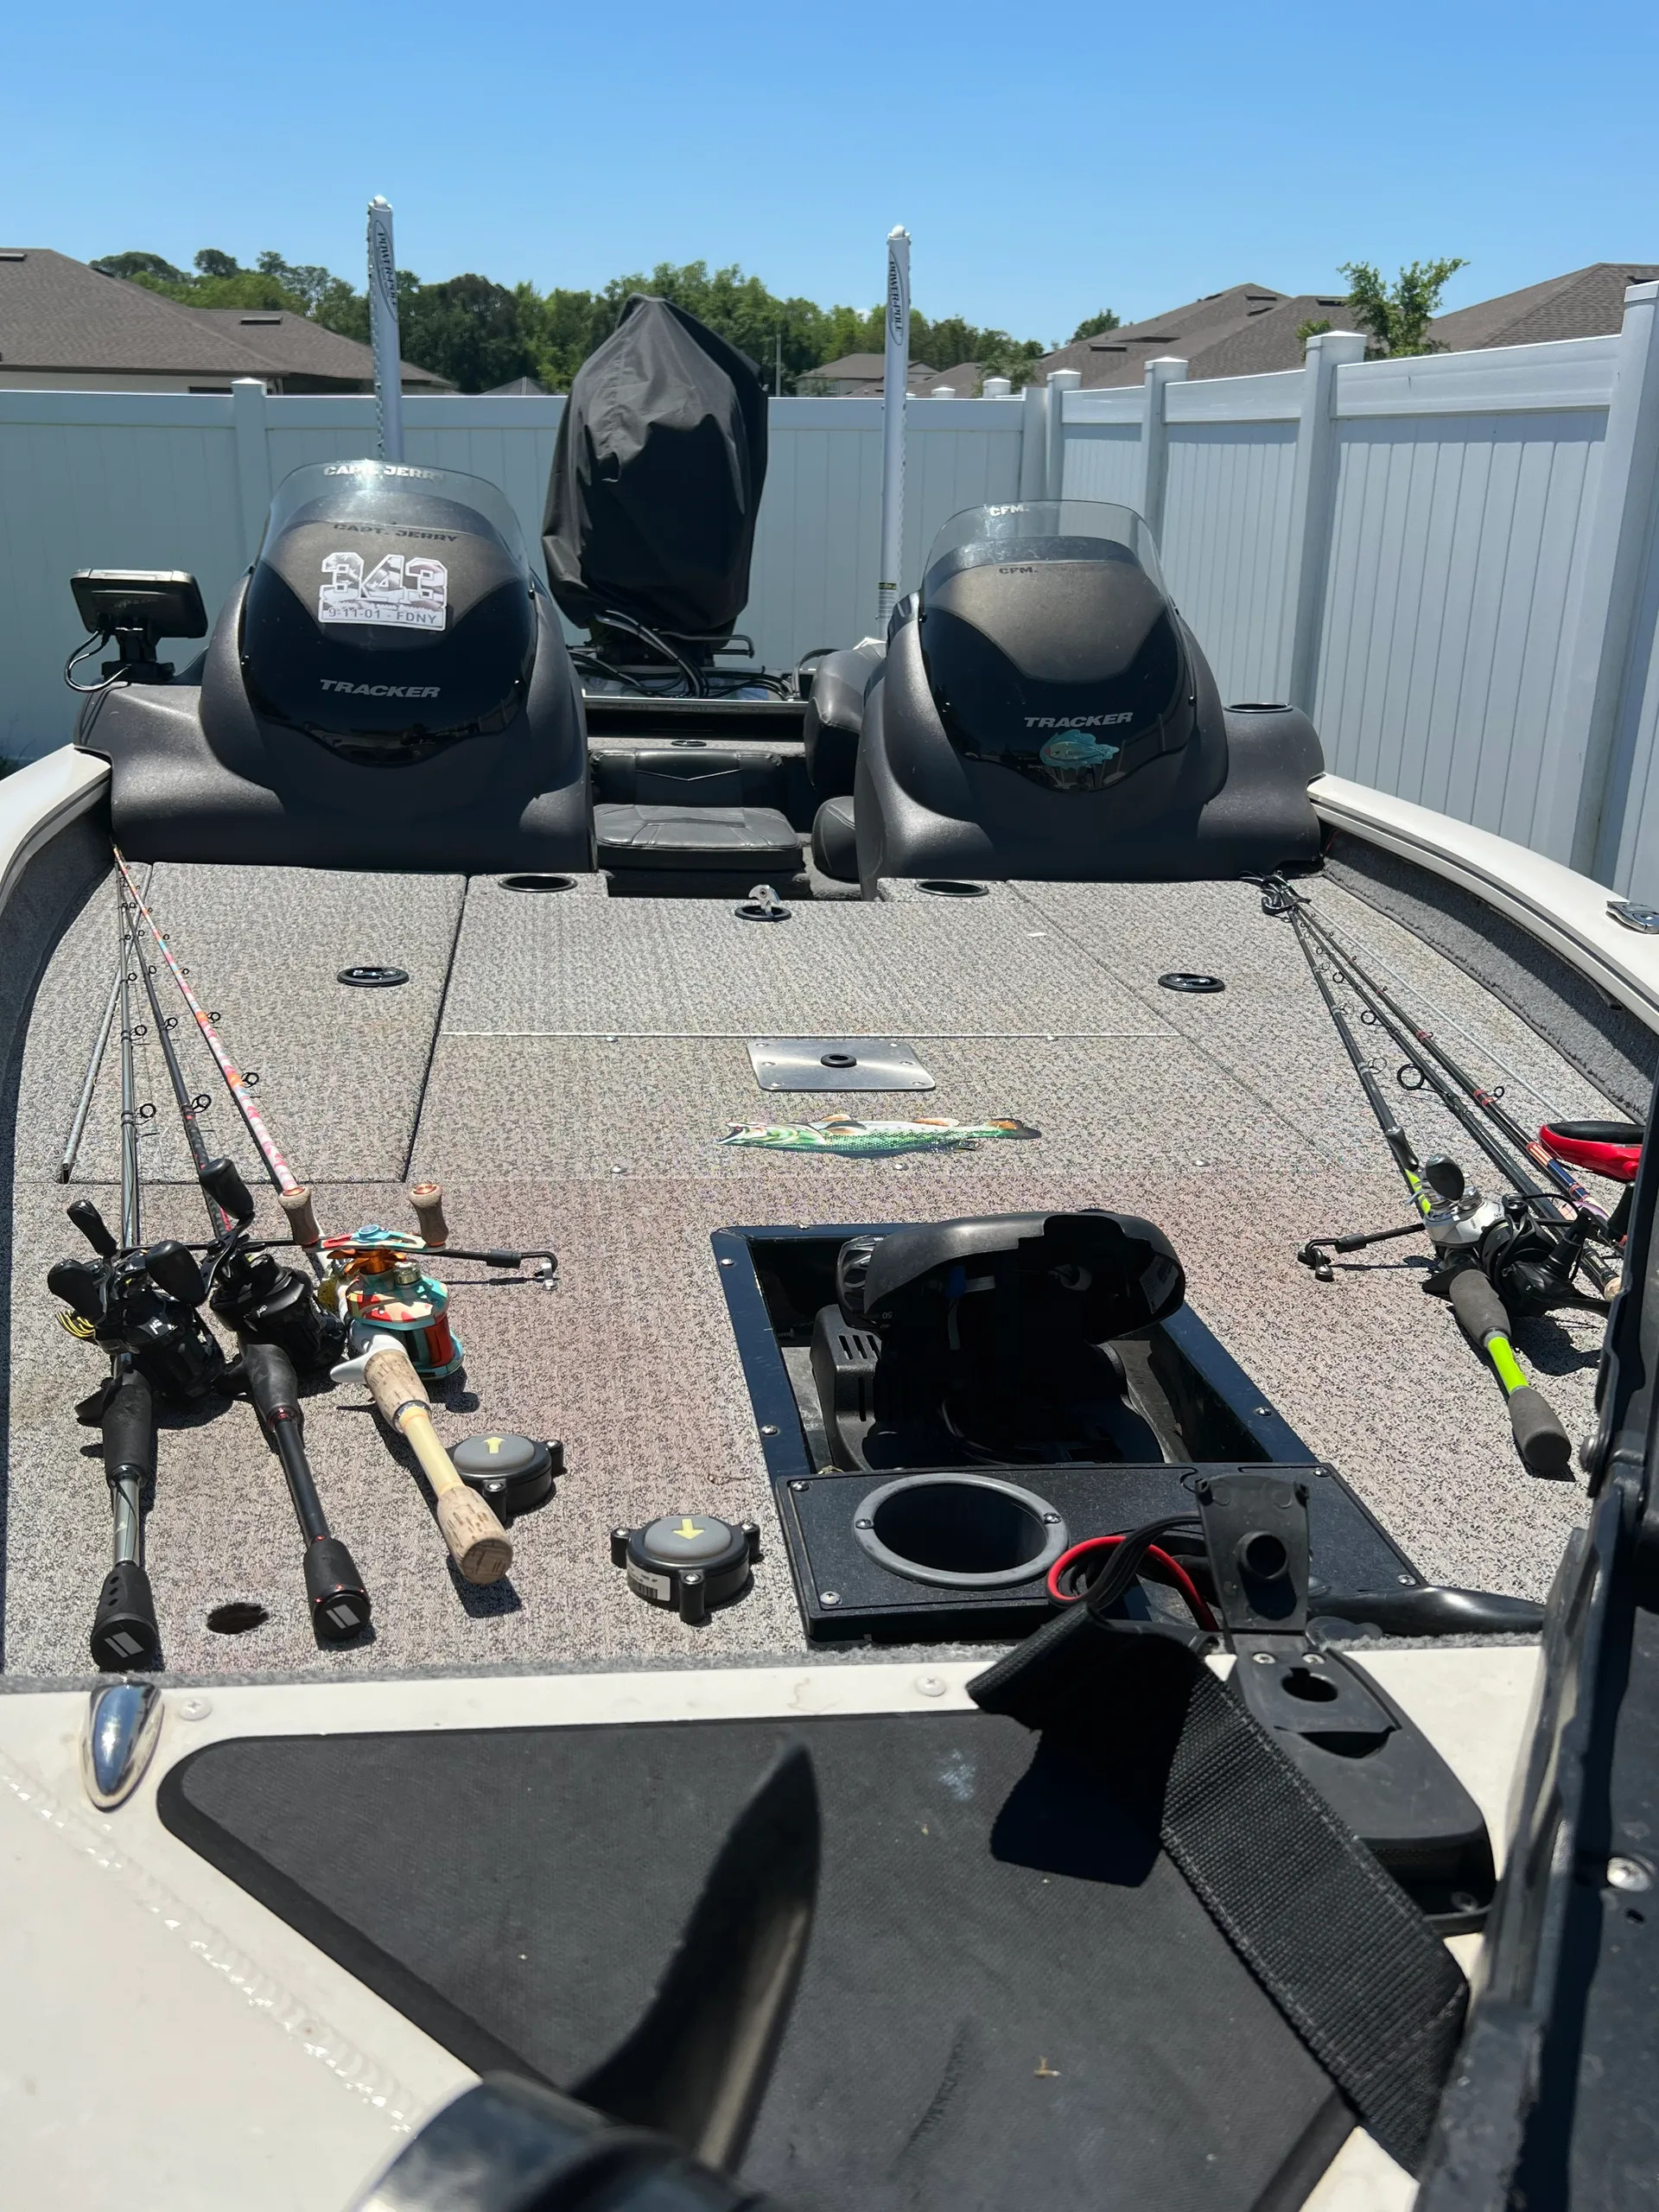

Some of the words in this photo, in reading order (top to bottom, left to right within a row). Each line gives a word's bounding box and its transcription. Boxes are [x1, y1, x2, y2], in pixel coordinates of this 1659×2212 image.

[395, 530, 459, 542] JERRY
[321, 552, 448, 606] 343
[328, 607, 380, 620] 9-11-01
[397, 611, 437, 624] FDNY
[320, 679, 441, 697] TRACKER
[1024, 712, 1134, 728] TRACKER
